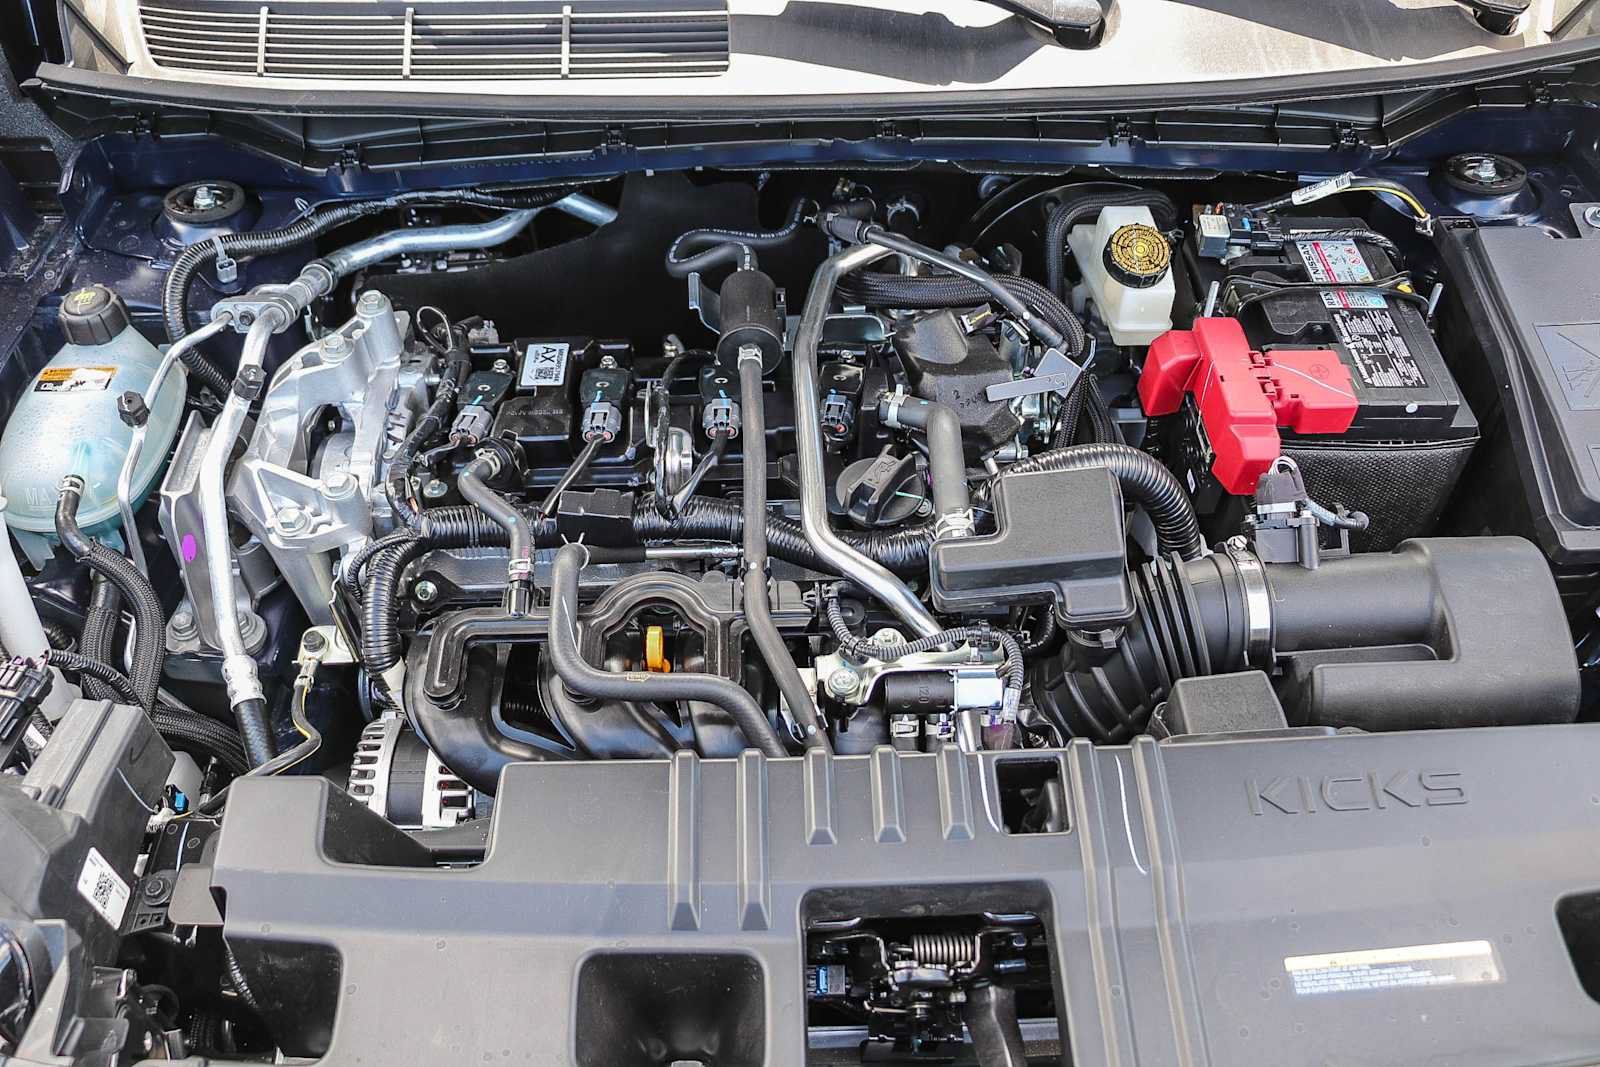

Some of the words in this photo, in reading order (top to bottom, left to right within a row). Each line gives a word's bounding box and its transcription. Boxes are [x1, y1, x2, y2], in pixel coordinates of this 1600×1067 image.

[1299, 243, 1321, 275] NISSAN
[540, 346, 557, 363] AX
[1245, 770, 1468, 816] KICKS
